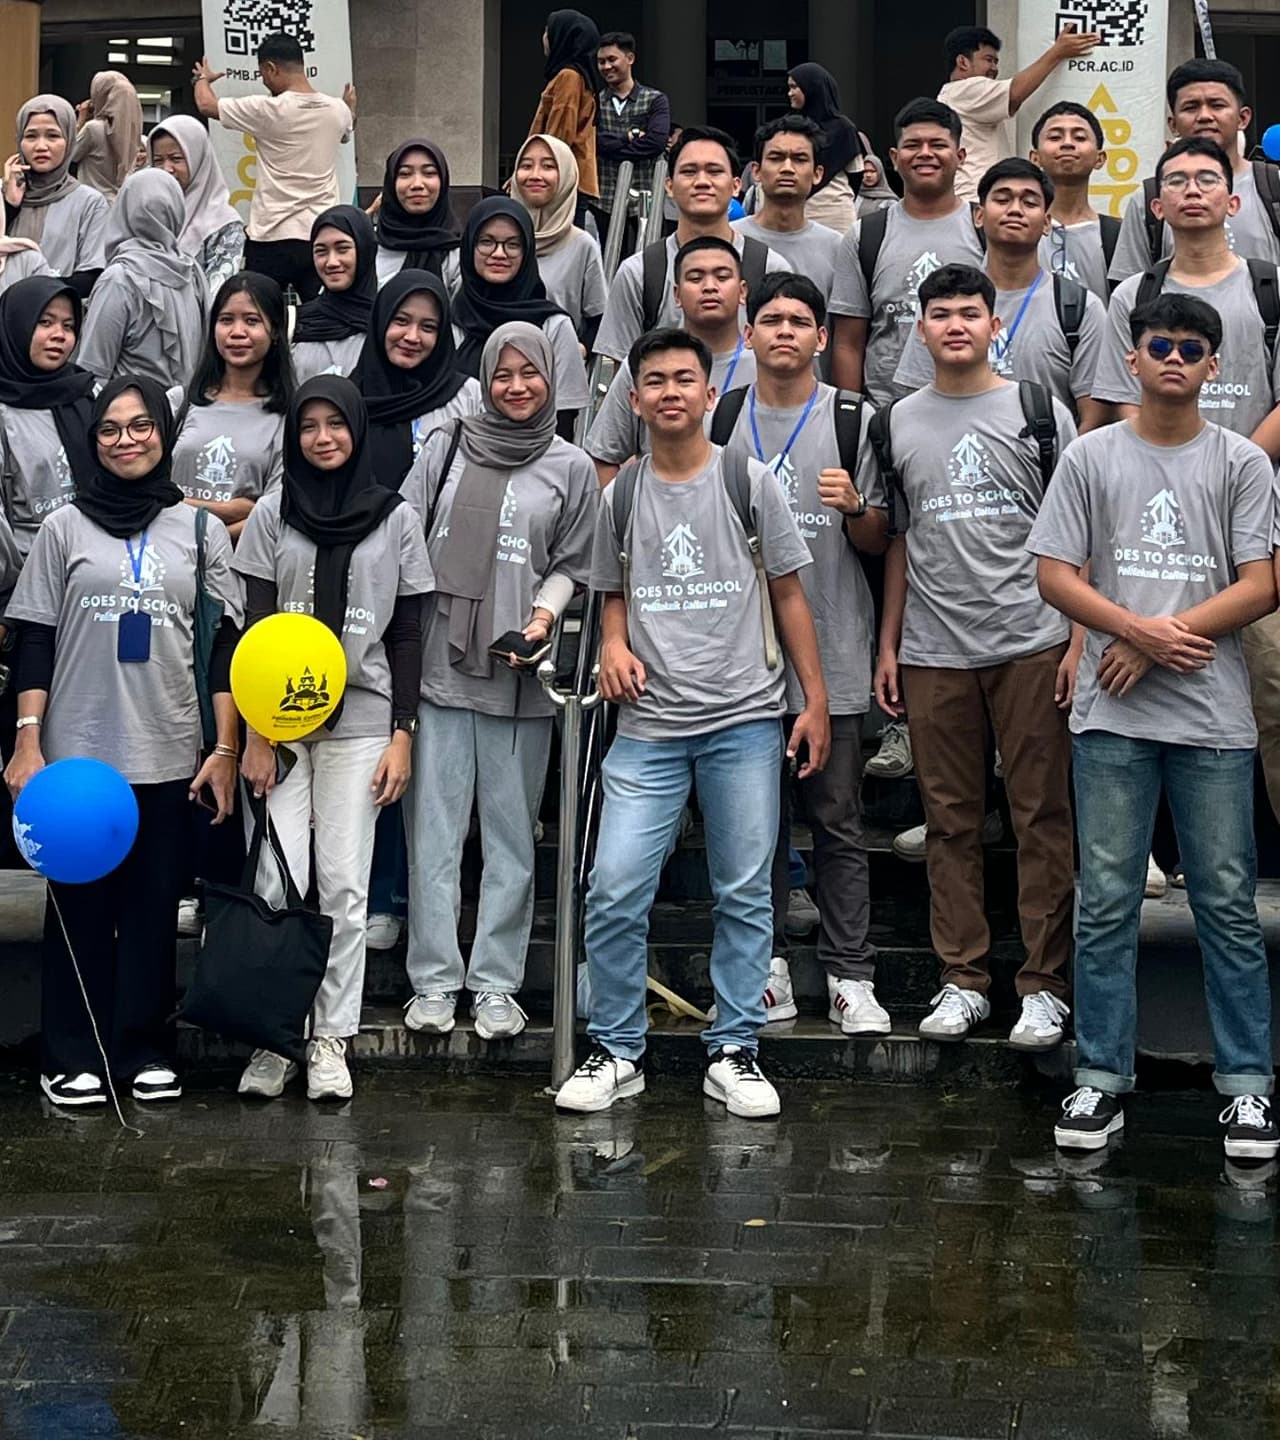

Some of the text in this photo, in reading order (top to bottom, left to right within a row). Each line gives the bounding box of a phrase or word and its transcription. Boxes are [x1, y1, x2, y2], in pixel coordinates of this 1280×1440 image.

[226, 66, 318, 81] PMB.PID
[1068, 60, 1134, 73] PCR.AC.ID
[1201, 382, 1251, 396] SCHOOL
[196, 487, 211, 500] TO
[921, 494, 952, 512] GOES
[955, 493, 974, 505] TO
[792, 511, 832, 526] HOOL
[497, 534, 528, 550] CHO
[1114, 548, 1140, 562] OES
[1143, 550, 1163, 564] TO
[635, 580, 742, 599] OES TO SCHOOL
[80, 595, 116, 608] GOES
[142, 598, 179, 614] SCHO
[284, 602, 305, 613] OES
